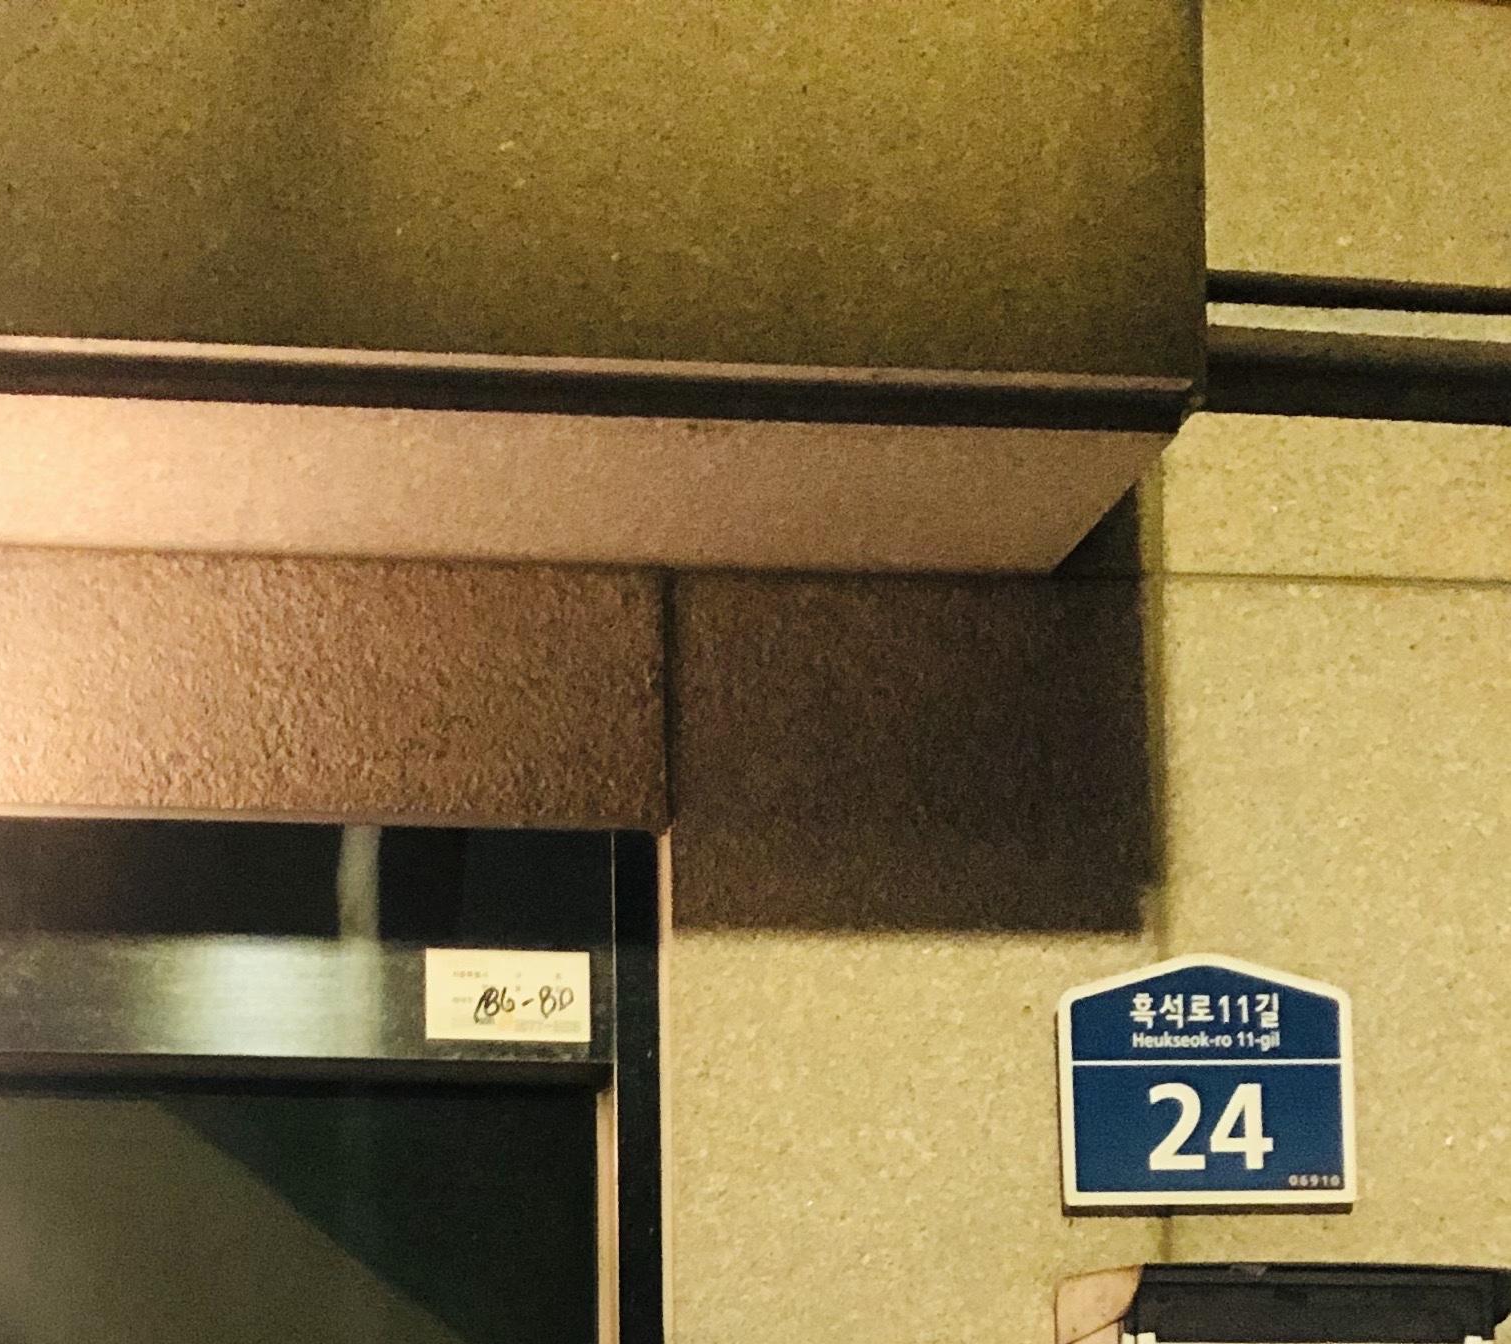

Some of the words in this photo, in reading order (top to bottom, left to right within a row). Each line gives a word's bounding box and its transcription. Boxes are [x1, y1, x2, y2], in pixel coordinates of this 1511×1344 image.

[1130, 992, 1280, 1029] 흑석로11길
[1132, 1031, 1233, 1049] Heukseok-ro
[1237, 1031, 1281, 1052] 11-gil
[1148, 1082, 1274, 1171] 24
